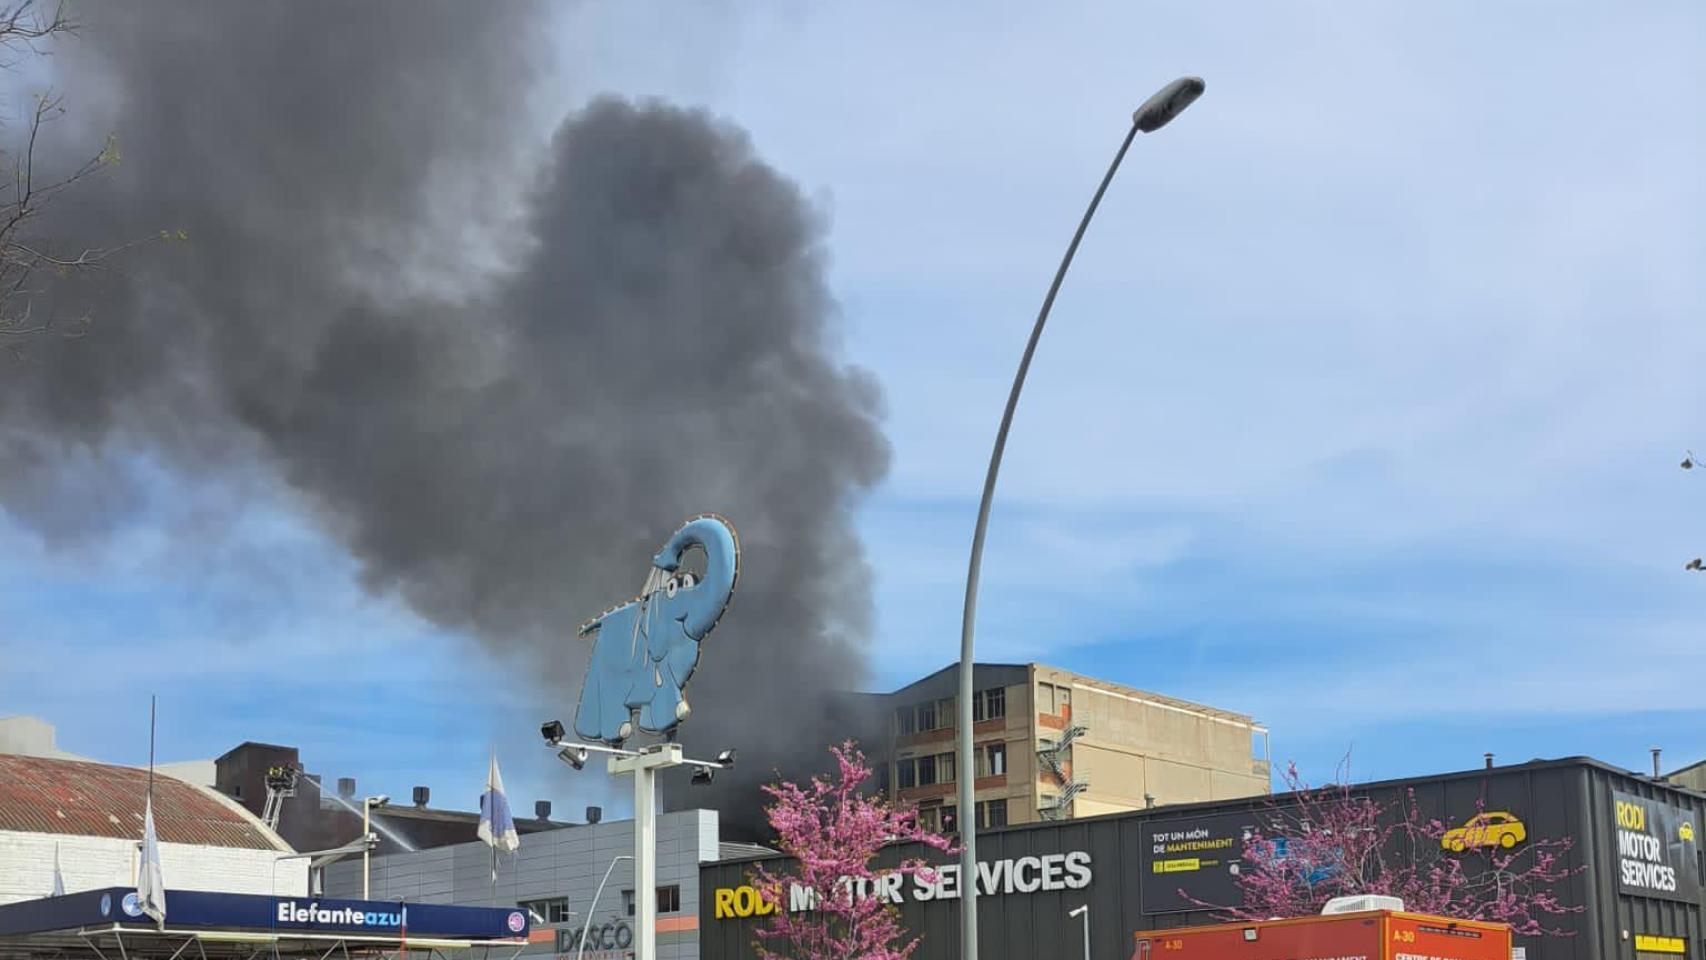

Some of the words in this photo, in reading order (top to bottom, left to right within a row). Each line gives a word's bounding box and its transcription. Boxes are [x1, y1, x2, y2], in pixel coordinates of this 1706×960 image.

[1616, 800, 1645, 831] RODI
[1153, 833, 1169, 842] TOT
[1171, 831, 1184, 840] UN
[1153, 844, 1165, 853] DE
[1166, 838, 1234, 852] MANTENIMENT
[1618, 830, 1661, 862] MOTOR
[1621, 858, 1676, 891] SERVICES
[790, 871, 904, 912] MTOR
[1393, 930, 1415, 942] A-30
